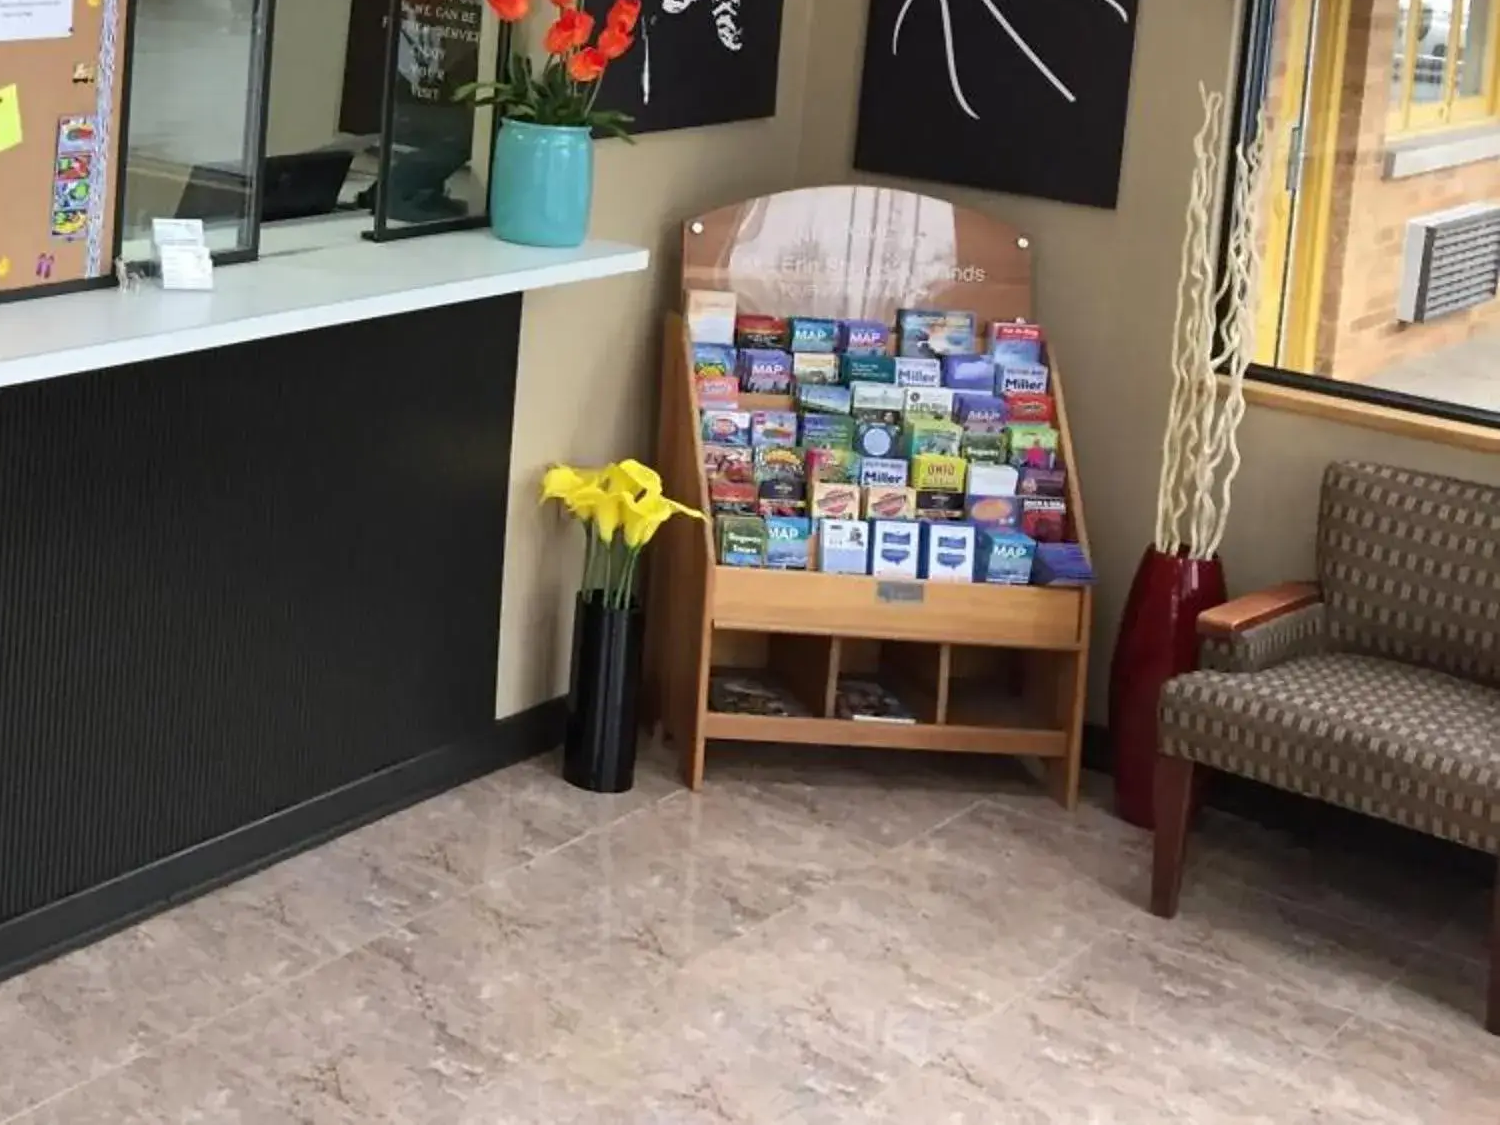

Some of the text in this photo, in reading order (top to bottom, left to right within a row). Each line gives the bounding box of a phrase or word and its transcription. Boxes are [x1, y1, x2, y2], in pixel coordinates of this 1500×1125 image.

[435, 6, 458, 20] CAN
[795, 330, 827, 341] MAP
[849, 331, 881, 343] MAP
[752, 364, 784, 375] MAP
[899, 370, 936, 382] Miller
[1005, 378, 1044, 391] Miller
[864, 470, 903, 483] Miller
[768, 526, 800, 539] MAP
[993, 544, 1027, 558] MAP
